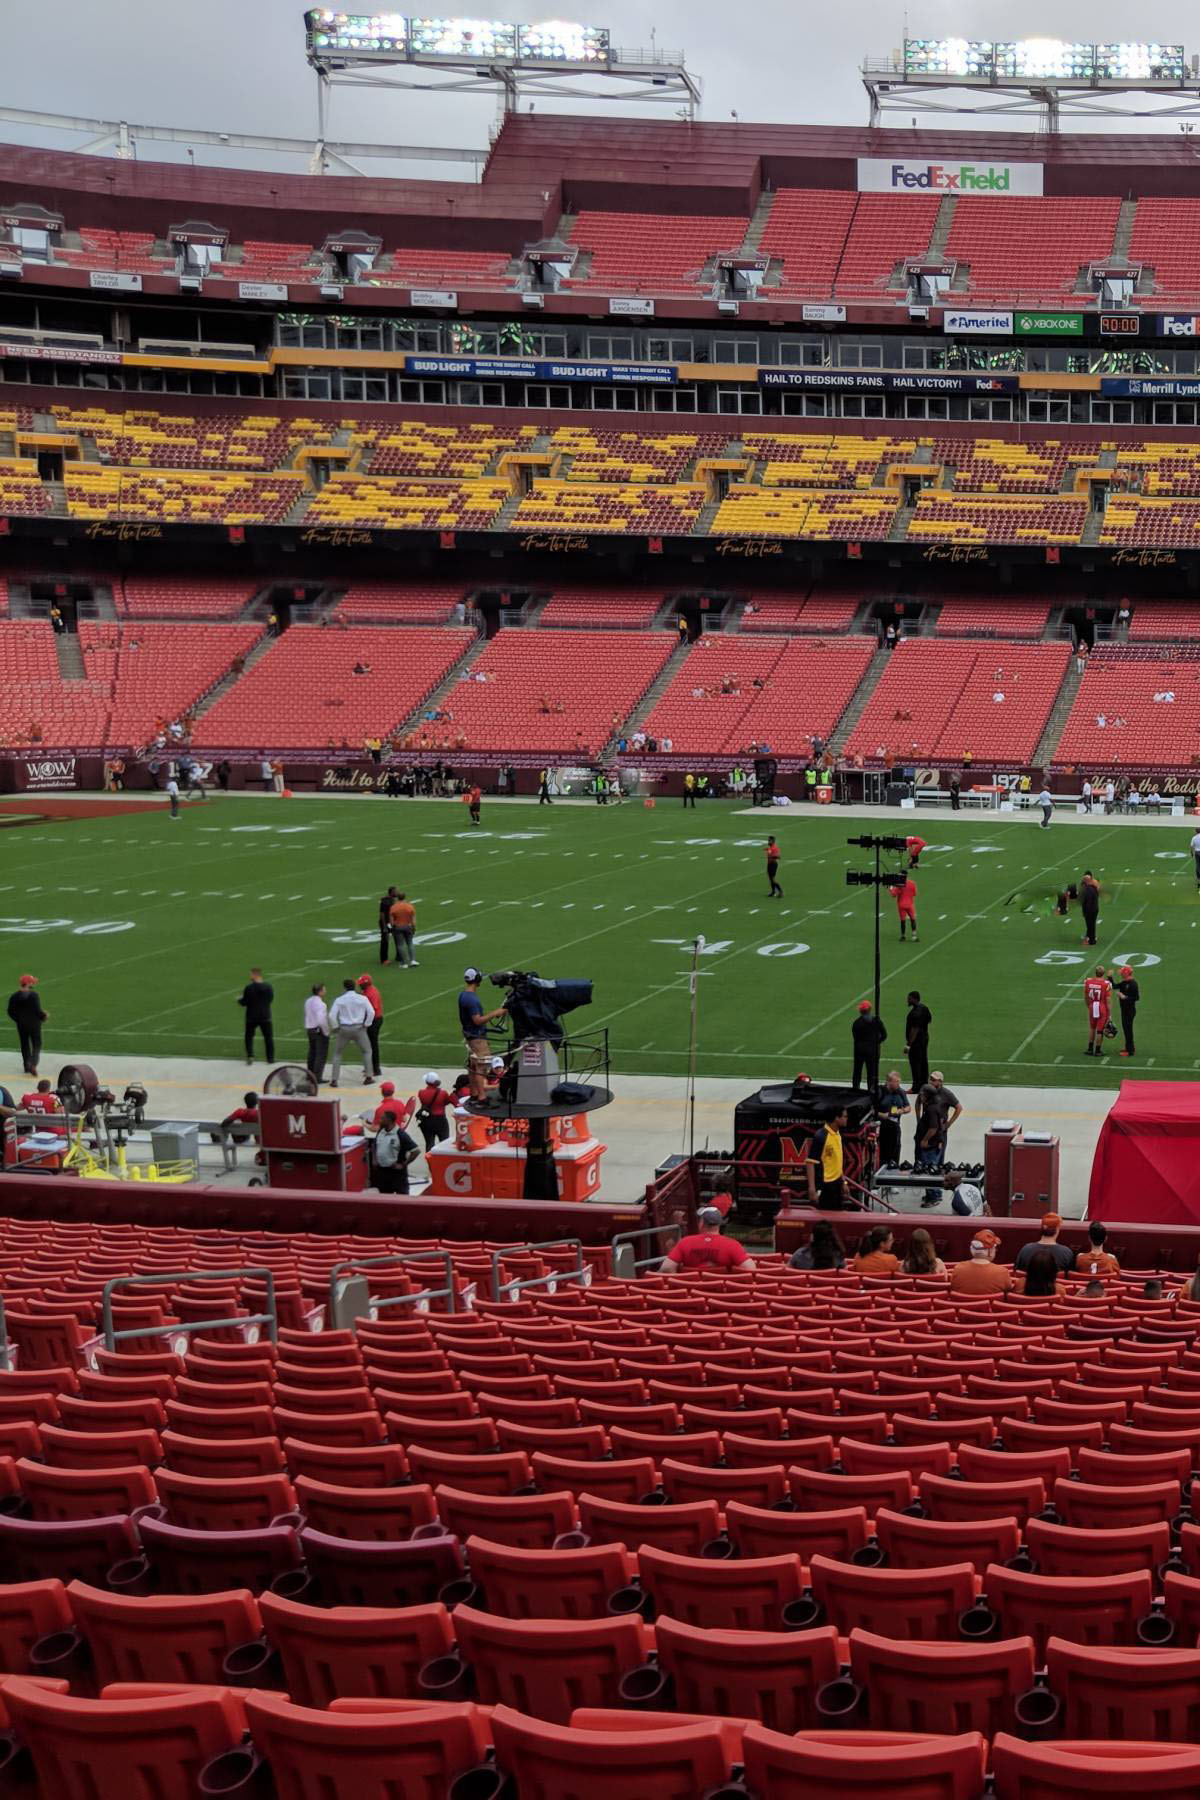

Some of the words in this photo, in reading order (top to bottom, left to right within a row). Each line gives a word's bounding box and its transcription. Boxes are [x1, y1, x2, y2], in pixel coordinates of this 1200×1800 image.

[892, 165, 1010, 190] FedExField
[958, 317, 1010, 328] Ameritel
[1034, 319, 1058, 329] XBOX
[1058, 320, 1078, 329] ONE
[414, 361, 438, 371] BUD
[440, 362, 471, 372] LIGHT
[552, 366, 575, 376] BUD
[576, 367, 608, 377] LIGHT
[765, 374, 787, 383] HAIL
[789, 375, 802, 384] TO
[804, 375, 854, 386] REDSKINS
[856, 376, 885, 386] FANS.
[893, 378, 916, 387] HAIL
[917, 378, 962, 388] VICTORY!
[976, 380, 1004, 390] FedEx
[1142, 380, 1174, 393] Merrill
[1137, 777, 1160, 793] the
[287, 1114, 307, 1134] M
[457, 1121, 468, 1135] G
[444, 1162, 472, 1193] G
[587, 1162, 597, 1186] G
